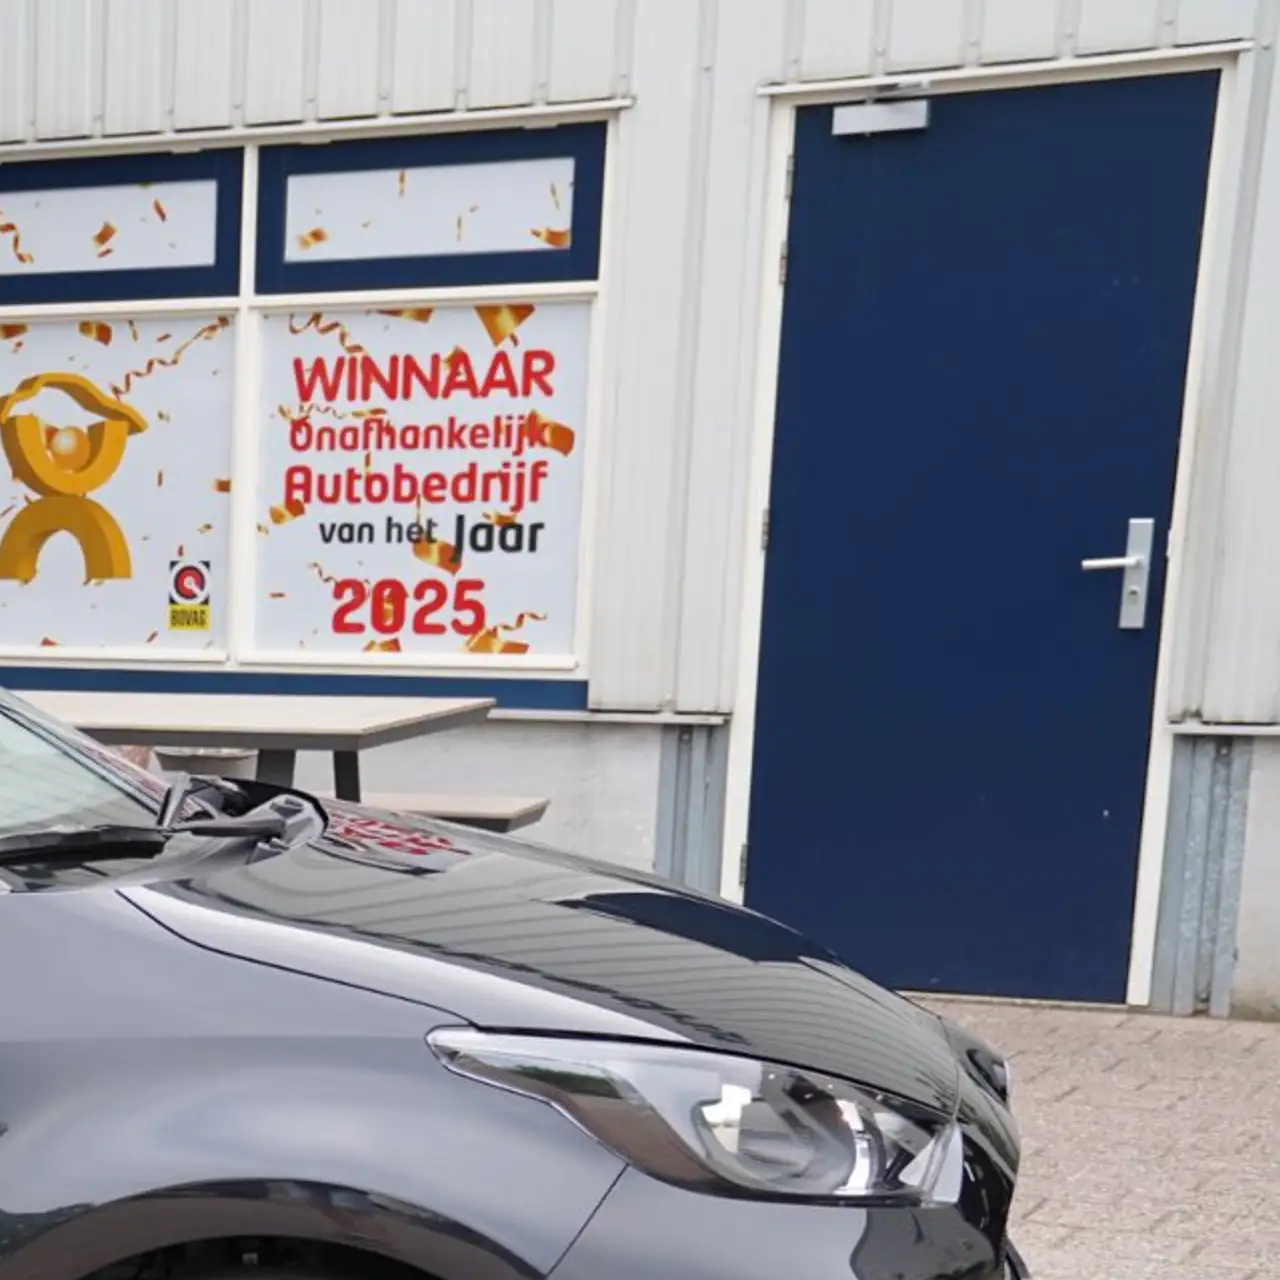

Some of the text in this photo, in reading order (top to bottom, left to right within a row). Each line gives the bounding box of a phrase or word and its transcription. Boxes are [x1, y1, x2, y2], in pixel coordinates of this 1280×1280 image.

[293, 349, 556, 402] WINNAAR
[289, 413, 548, 456] Onafhankelijk
[285, 460, 549, 513] Autobedrijf
[319, 514, 546, 563] van het Jaar
[171, 608, 208, 628] BOVAG
[331, 578, 486, 636] 2025
